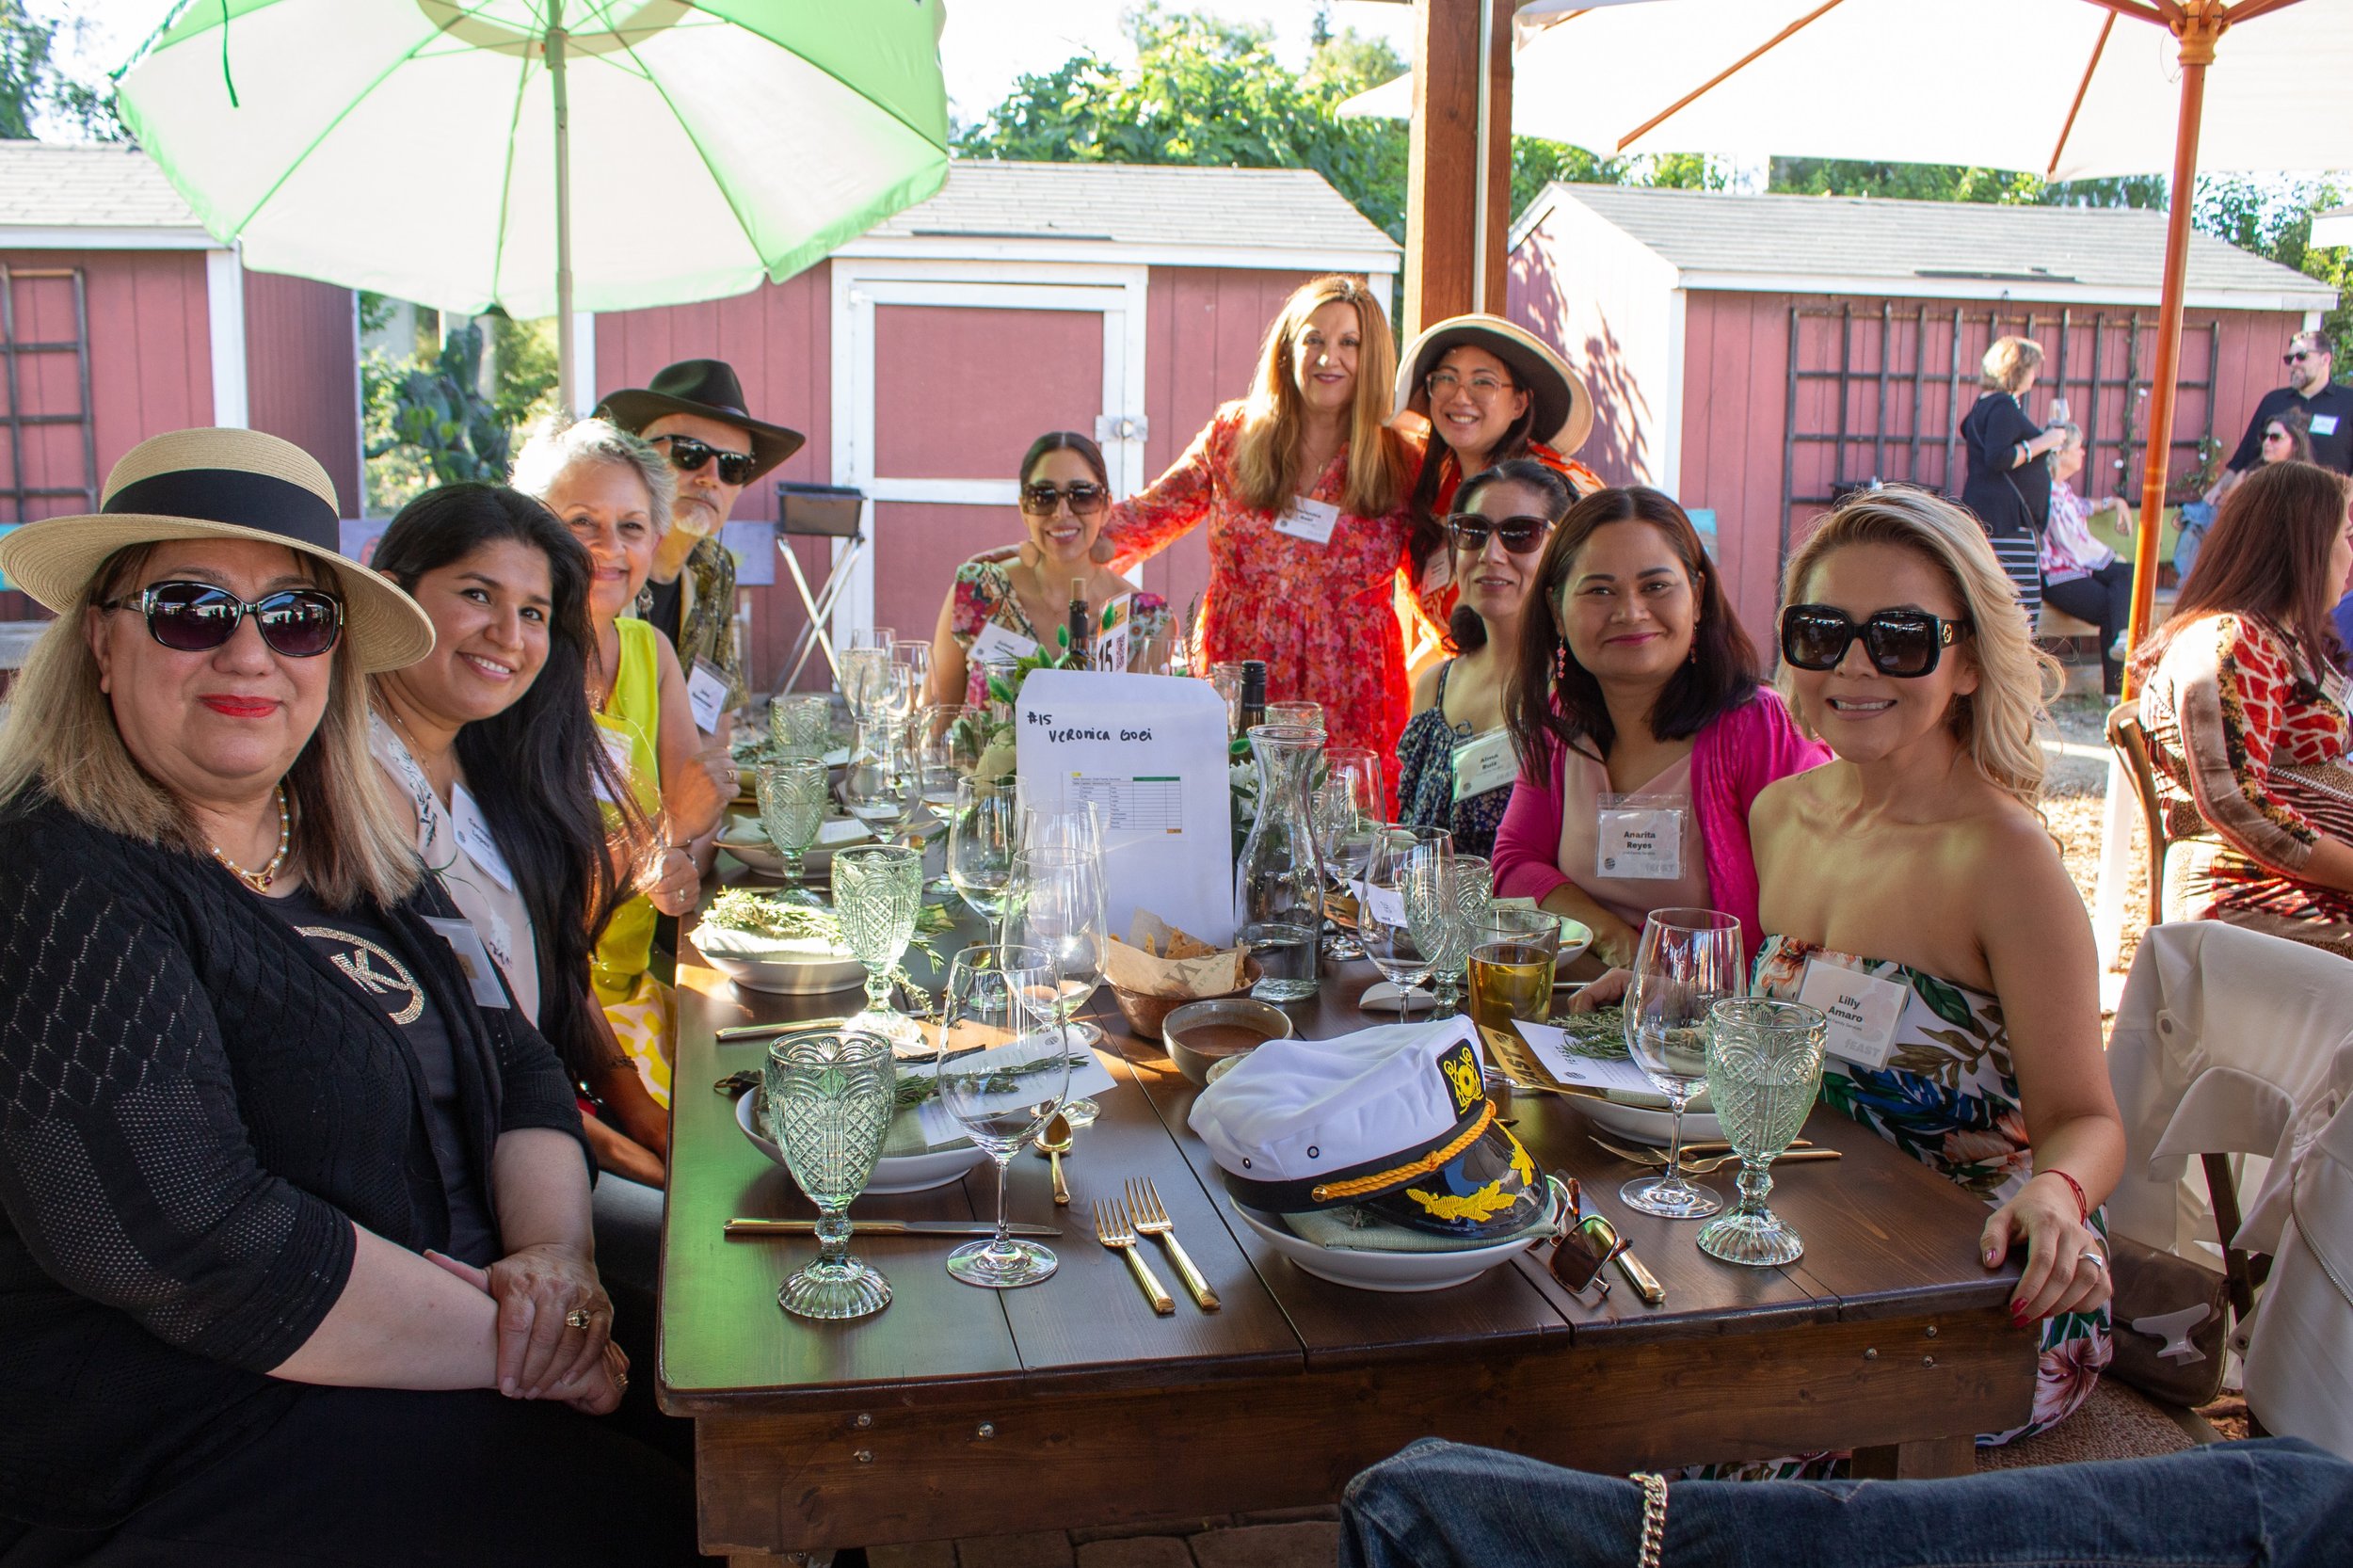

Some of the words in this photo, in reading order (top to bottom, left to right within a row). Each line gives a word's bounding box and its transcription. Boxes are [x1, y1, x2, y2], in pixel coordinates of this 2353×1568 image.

[1099, 639, 1112, 672] 15
[1027, 711, 1052, 726] #15
[1120, 728, 1153, 742] Goei
[1624, 830, 1657, 839] Anarita
[1626, 841, 1653, 851] Reyes
[1838, 994, 1861, 1010] Lilly
[1828, 1005, 1864, 1023] Amaro
